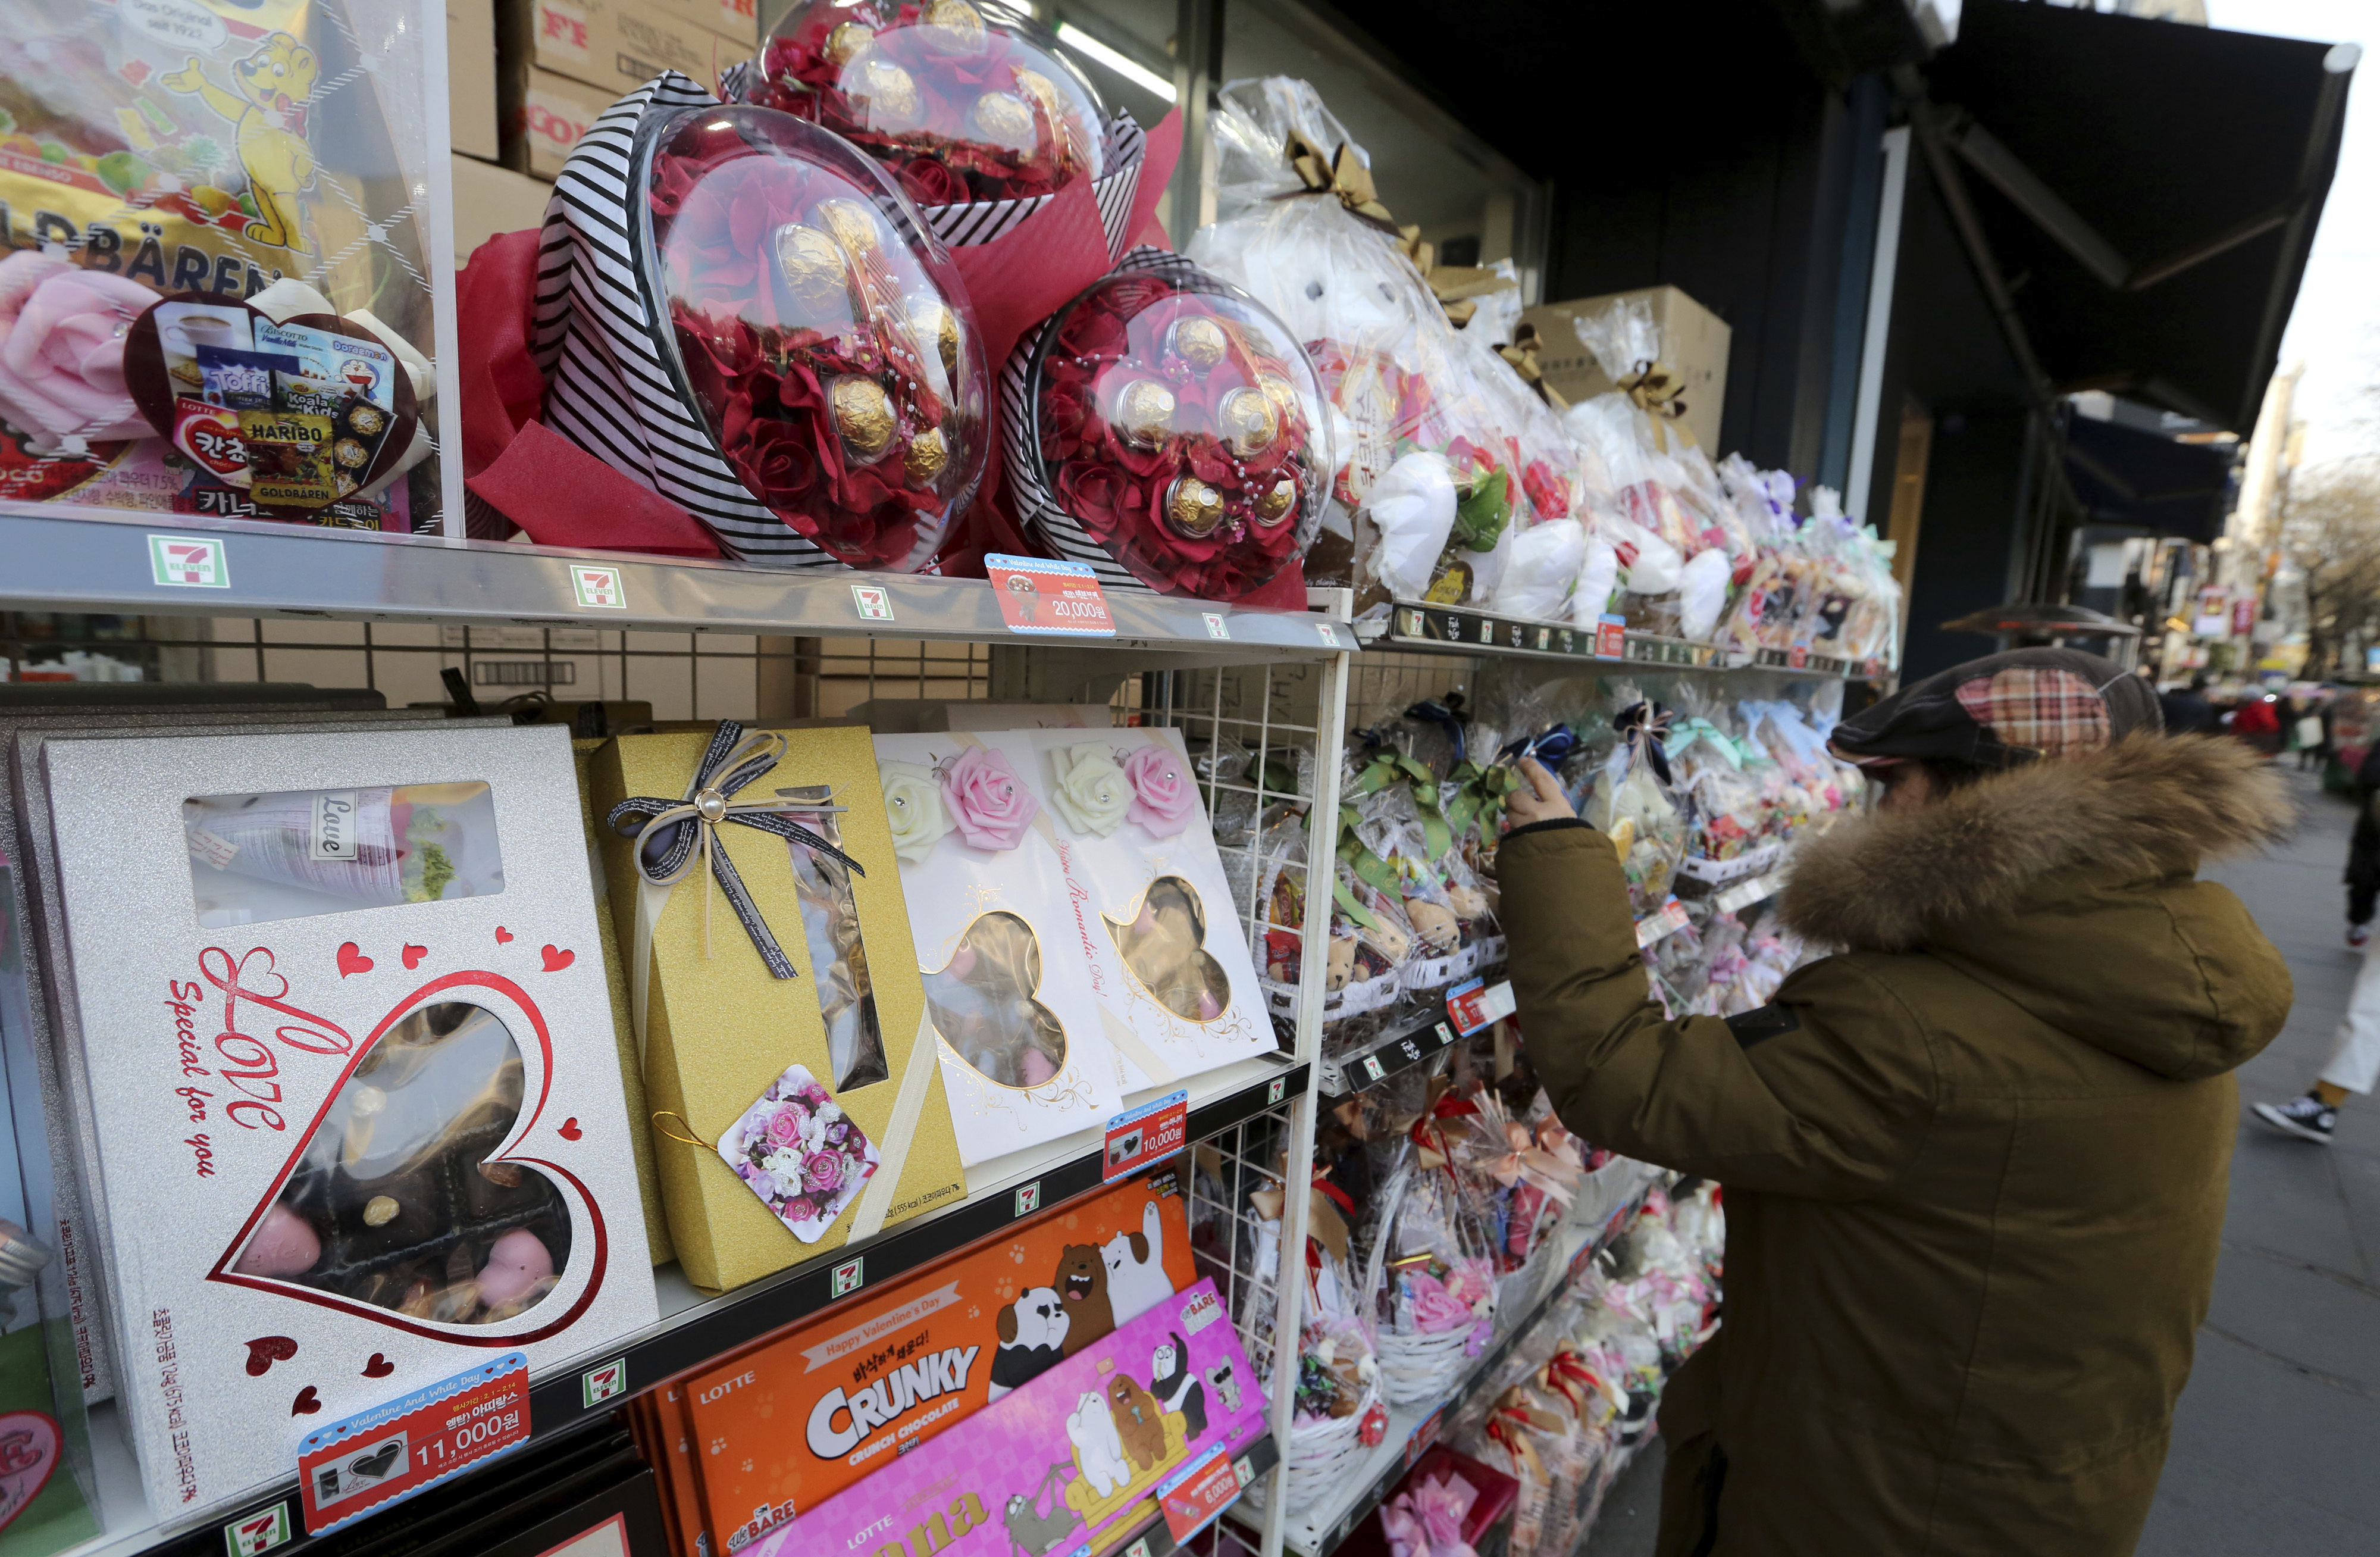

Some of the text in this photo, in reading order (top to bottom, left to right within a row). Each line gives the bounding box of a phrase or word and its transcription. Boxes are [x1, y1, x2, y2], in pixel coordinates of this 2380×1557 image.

[261, 324, 308, 342] BISCOTTO
[333, 340, 389, 362] Doraemon
[181, 402, 216, 416] LOTTE
[288, 392, 329, 408] Koala
[252, 423, 322, 442] HARIBO
[259, 486, 330, 499] GOLDBÄREN
[168, 545, 208, 583] 7
[1009, 558, 1072, 573] Valentine And White Day
[583, 573, 610, 604] 7
[860, 591, 881, 618] 7
[1053, 600, 1107, 623] 20,000원
[1208, 617, 1223, 637] 7
[321, 796, 351, 853] Love
[1065, 877, 1098, 961] Romantic
[1088, 964, 1108, 998] Day!
[164, 980, 215, 1178] Special for you
[1368, 1061, 1380, 1077] 7
[1273, 1083, 1282, 1100] 7
[1144, 1126, 1183, 1153] 10,000원
[1022, 1188, 1035, 1211] 7
[840, 1265, 856, 1291] 7
[825, 1296, 941, 1358] Happy Valentine's Day
[852, 1329, 930, 1384] 바삭하게 채운다!
[593, 1367, 616, 1399] 7
[699, 1370, 757, 1406] LOTTE
[351, 1373, 480, 1429] Valentine And White Day
[452, 1396, 480, 1412] 행사기간
[471, 1391, 519, 1418] 아띠랑스
[806, 1345, 981, 1459] CRUNKY
[416, 1409, 521, 1467] 11,000원
[848, 1397, 960, 1467] CRUNCH CHOCOLATE
[241, 1513, 274, 1552] 7
[747, 1500, 794, 1539] BARE
[847, 1514, 895, 1551] LOTTE
